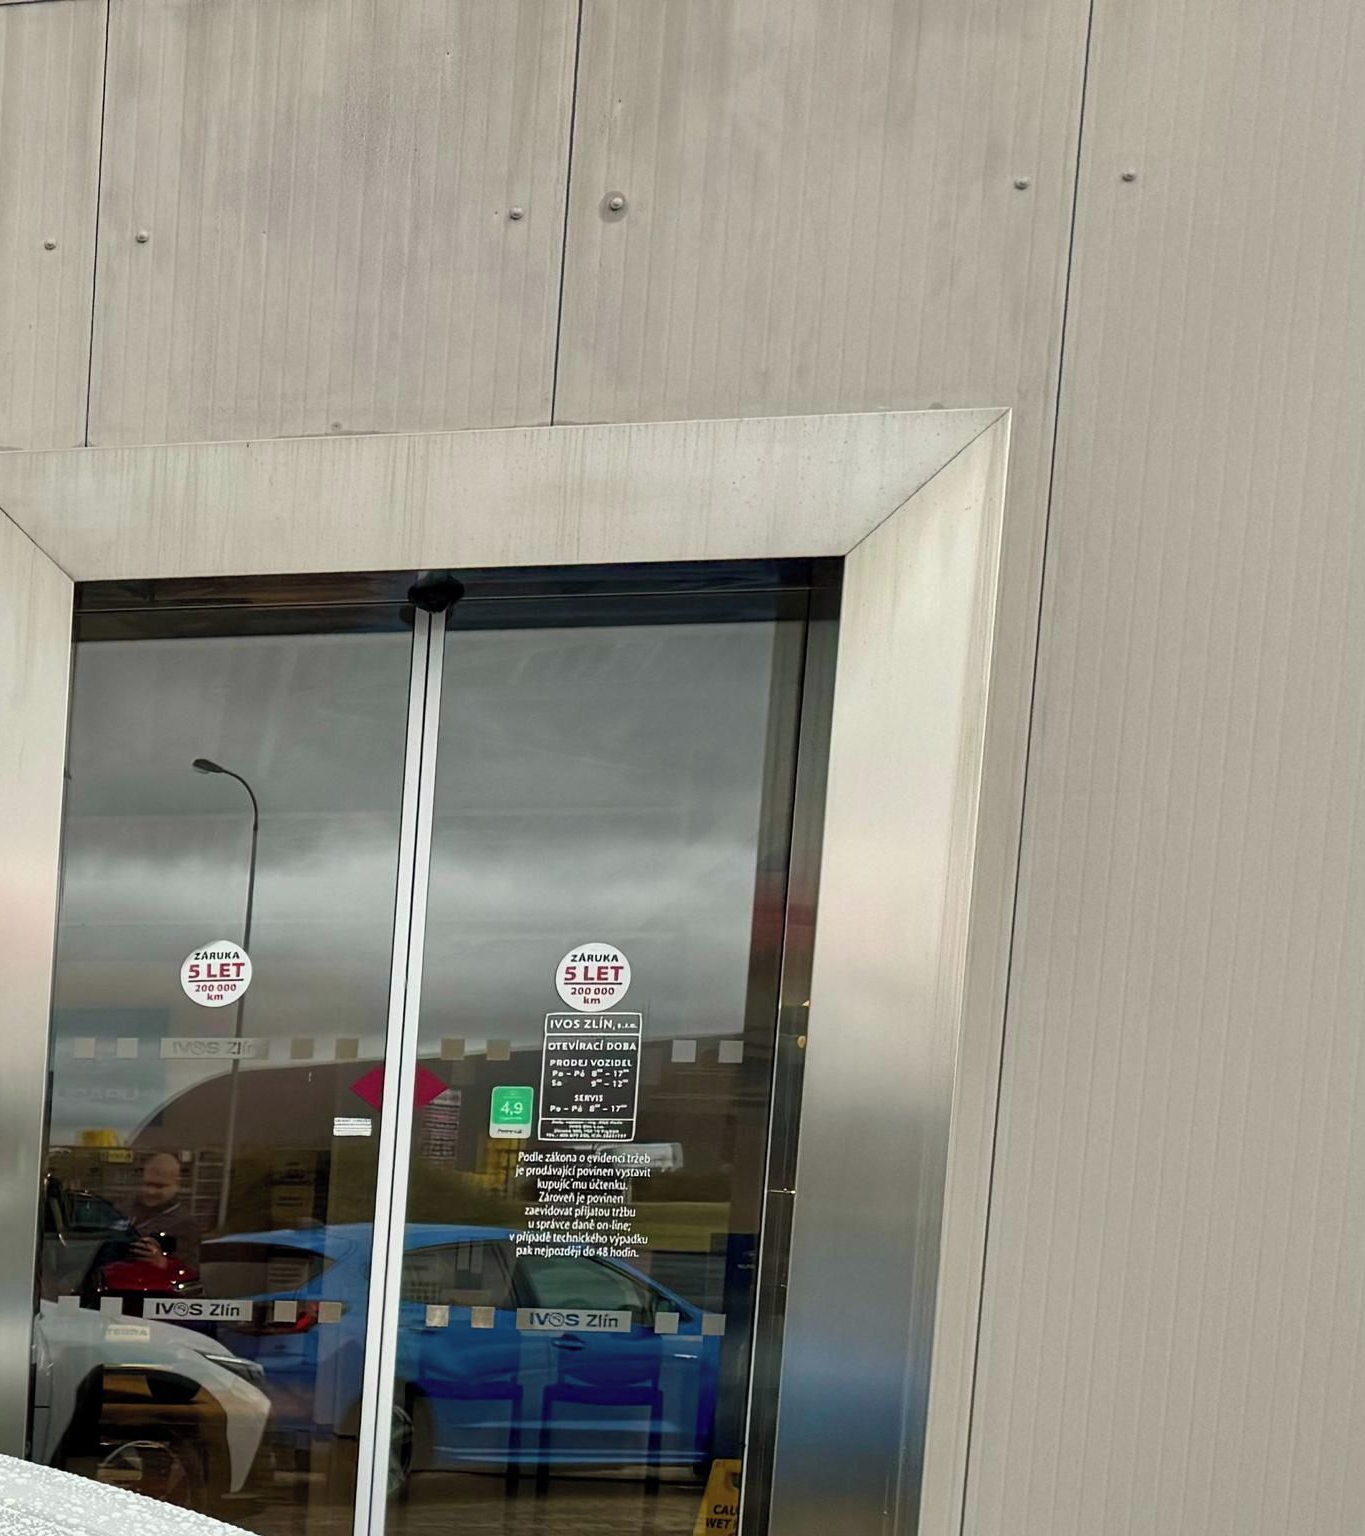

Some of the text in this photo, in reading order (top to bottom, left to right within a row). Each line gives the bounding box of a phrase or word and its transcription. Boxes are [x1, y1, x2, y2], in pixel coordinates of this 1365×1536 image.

[194, 951, 240, 960] ZÁRUKA
[571, 953, 618, 962] ZÁRUKA
[188, 962, 245, 978] 5 LET
[564, 966, 624, 981] 5 LET
[195, 984, 236, 992] 200 000
[571, 987, 615, 995] 200 000
[583, 996, 600, 1004] km
[550, 1019, 580, 1029] IVOS
[584, 1016, 615, 1030] ZLÍN,
[172, 1040, 220, 1055] IVOS
[548, 1040, 637, 1051] OTEVÍRACÍ DOBA
[550, 1059, 632, 1067] PRODEJ VOZIDEL
[574, 1094, 603, 1102] SERVIS
[500, 1101, 524, 1115] 4,9
[518, 1152, 650, 1163] Podle zákona o evidenci tržeb
[515, 1165, 651, 1178] je prodávající povinen vystavit
[537, 1178, 628, 1191] kupujícmu účtenku.
[538, 1191, 624, 1204] Zároveň je povinen
[524, 1205, 636, 1218] zaevidovat přijatou tržbu
[528, 1221, 535, 1229] u
[536, 1219, 570, 1230] správce
[572, 1220, 594, 1230] daně
[509, 1232, 648, 1246] v případě technického výpadku
[516, 1245, 639, 1258] pak nejpozději do 48 hodin.
[155, 1302, 240, 1317] IVOS Zlín
[530, 1312, 618, 1328] IVOS Zlín
[705, 1518, 731, 1529] WET
